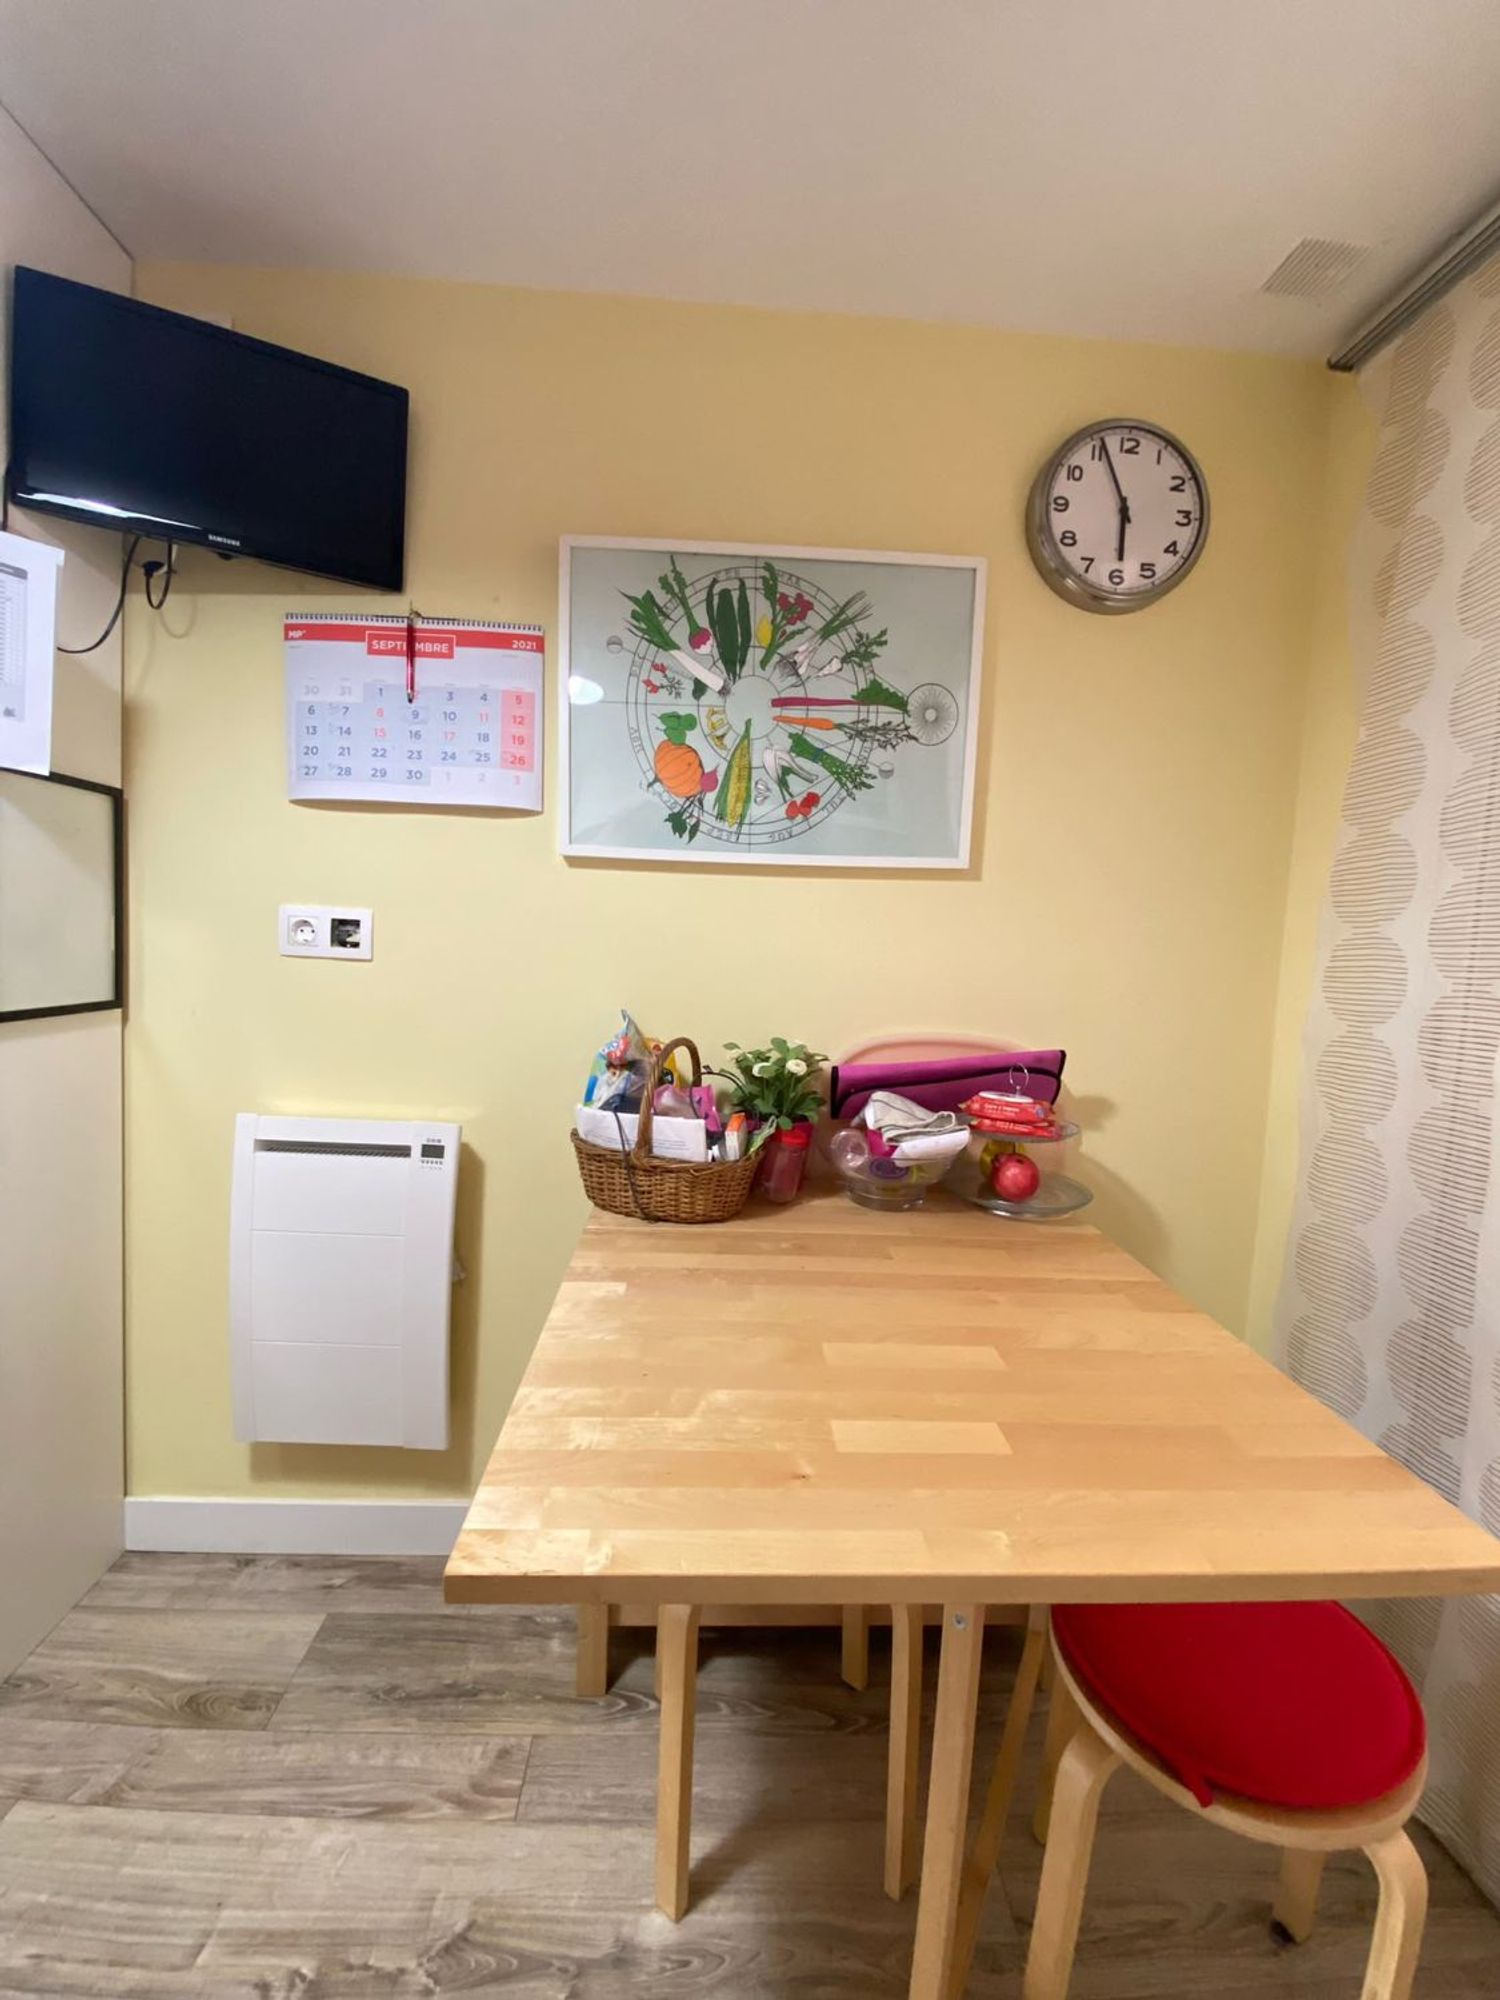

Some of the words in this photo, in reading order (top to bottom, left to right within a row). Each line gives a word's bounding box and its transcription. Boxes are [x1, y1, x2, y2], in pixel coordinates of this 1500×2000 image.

[1090, 442, 1103, 462] 11
[1119, 436, 1140, 455] 12
[1156, 448, 1162, 465] 1
[1066, 464, 1083, 482] 10
[1169, 475, 1186, 493] 2
[1052, 495, 1070, 512] 9
[1175, 509, 1192, 527] 3
[1060, 530, 1078, 547] 8
[1163, 540, 1180, 557] 4
[1080, 556, 1095, 574] 7
[1139, 562, 1156, 579] 5
[1108, 568, 1125, 586] 6
[372, 640, 449, 653] SEPTIMBRE
[511, 640, 537, 650] 2021
[304, 685, 319, 696] 30
[339, 686, 352, 697] 31
[447, 691, 454, 701] 3
[480, 693, 488, 702] 4
[307, 704, 316, 715] 6
[342, 706, 350, 716] 7
[411, 709, 420, 720] 9
[443, 711, 457, 721] 10
[480, 712, 488, 723] 11
[512, 715, 525, 725] 12
[306, 725, 317, 735] 13
[339, 726, 351, 736] 14
[409, 730, 422, 740] 16
[445, 731, 456, 742] 17
[478, 732, 490, 742] 18
[303, 745, 319, 756] 20
[338, 746, 351, 756] 21
[371, 748, 387, 758] 22
[407, 750, 422, 760] 23
[441, 751, 457, 761] 24
[475, 752, 490, 762] 25
[303, 765, 319, 776] 27
[337, 766, 352, 776] 28
[371, 768, 387, 778] 29
[406, 769, 423, 780] 30
